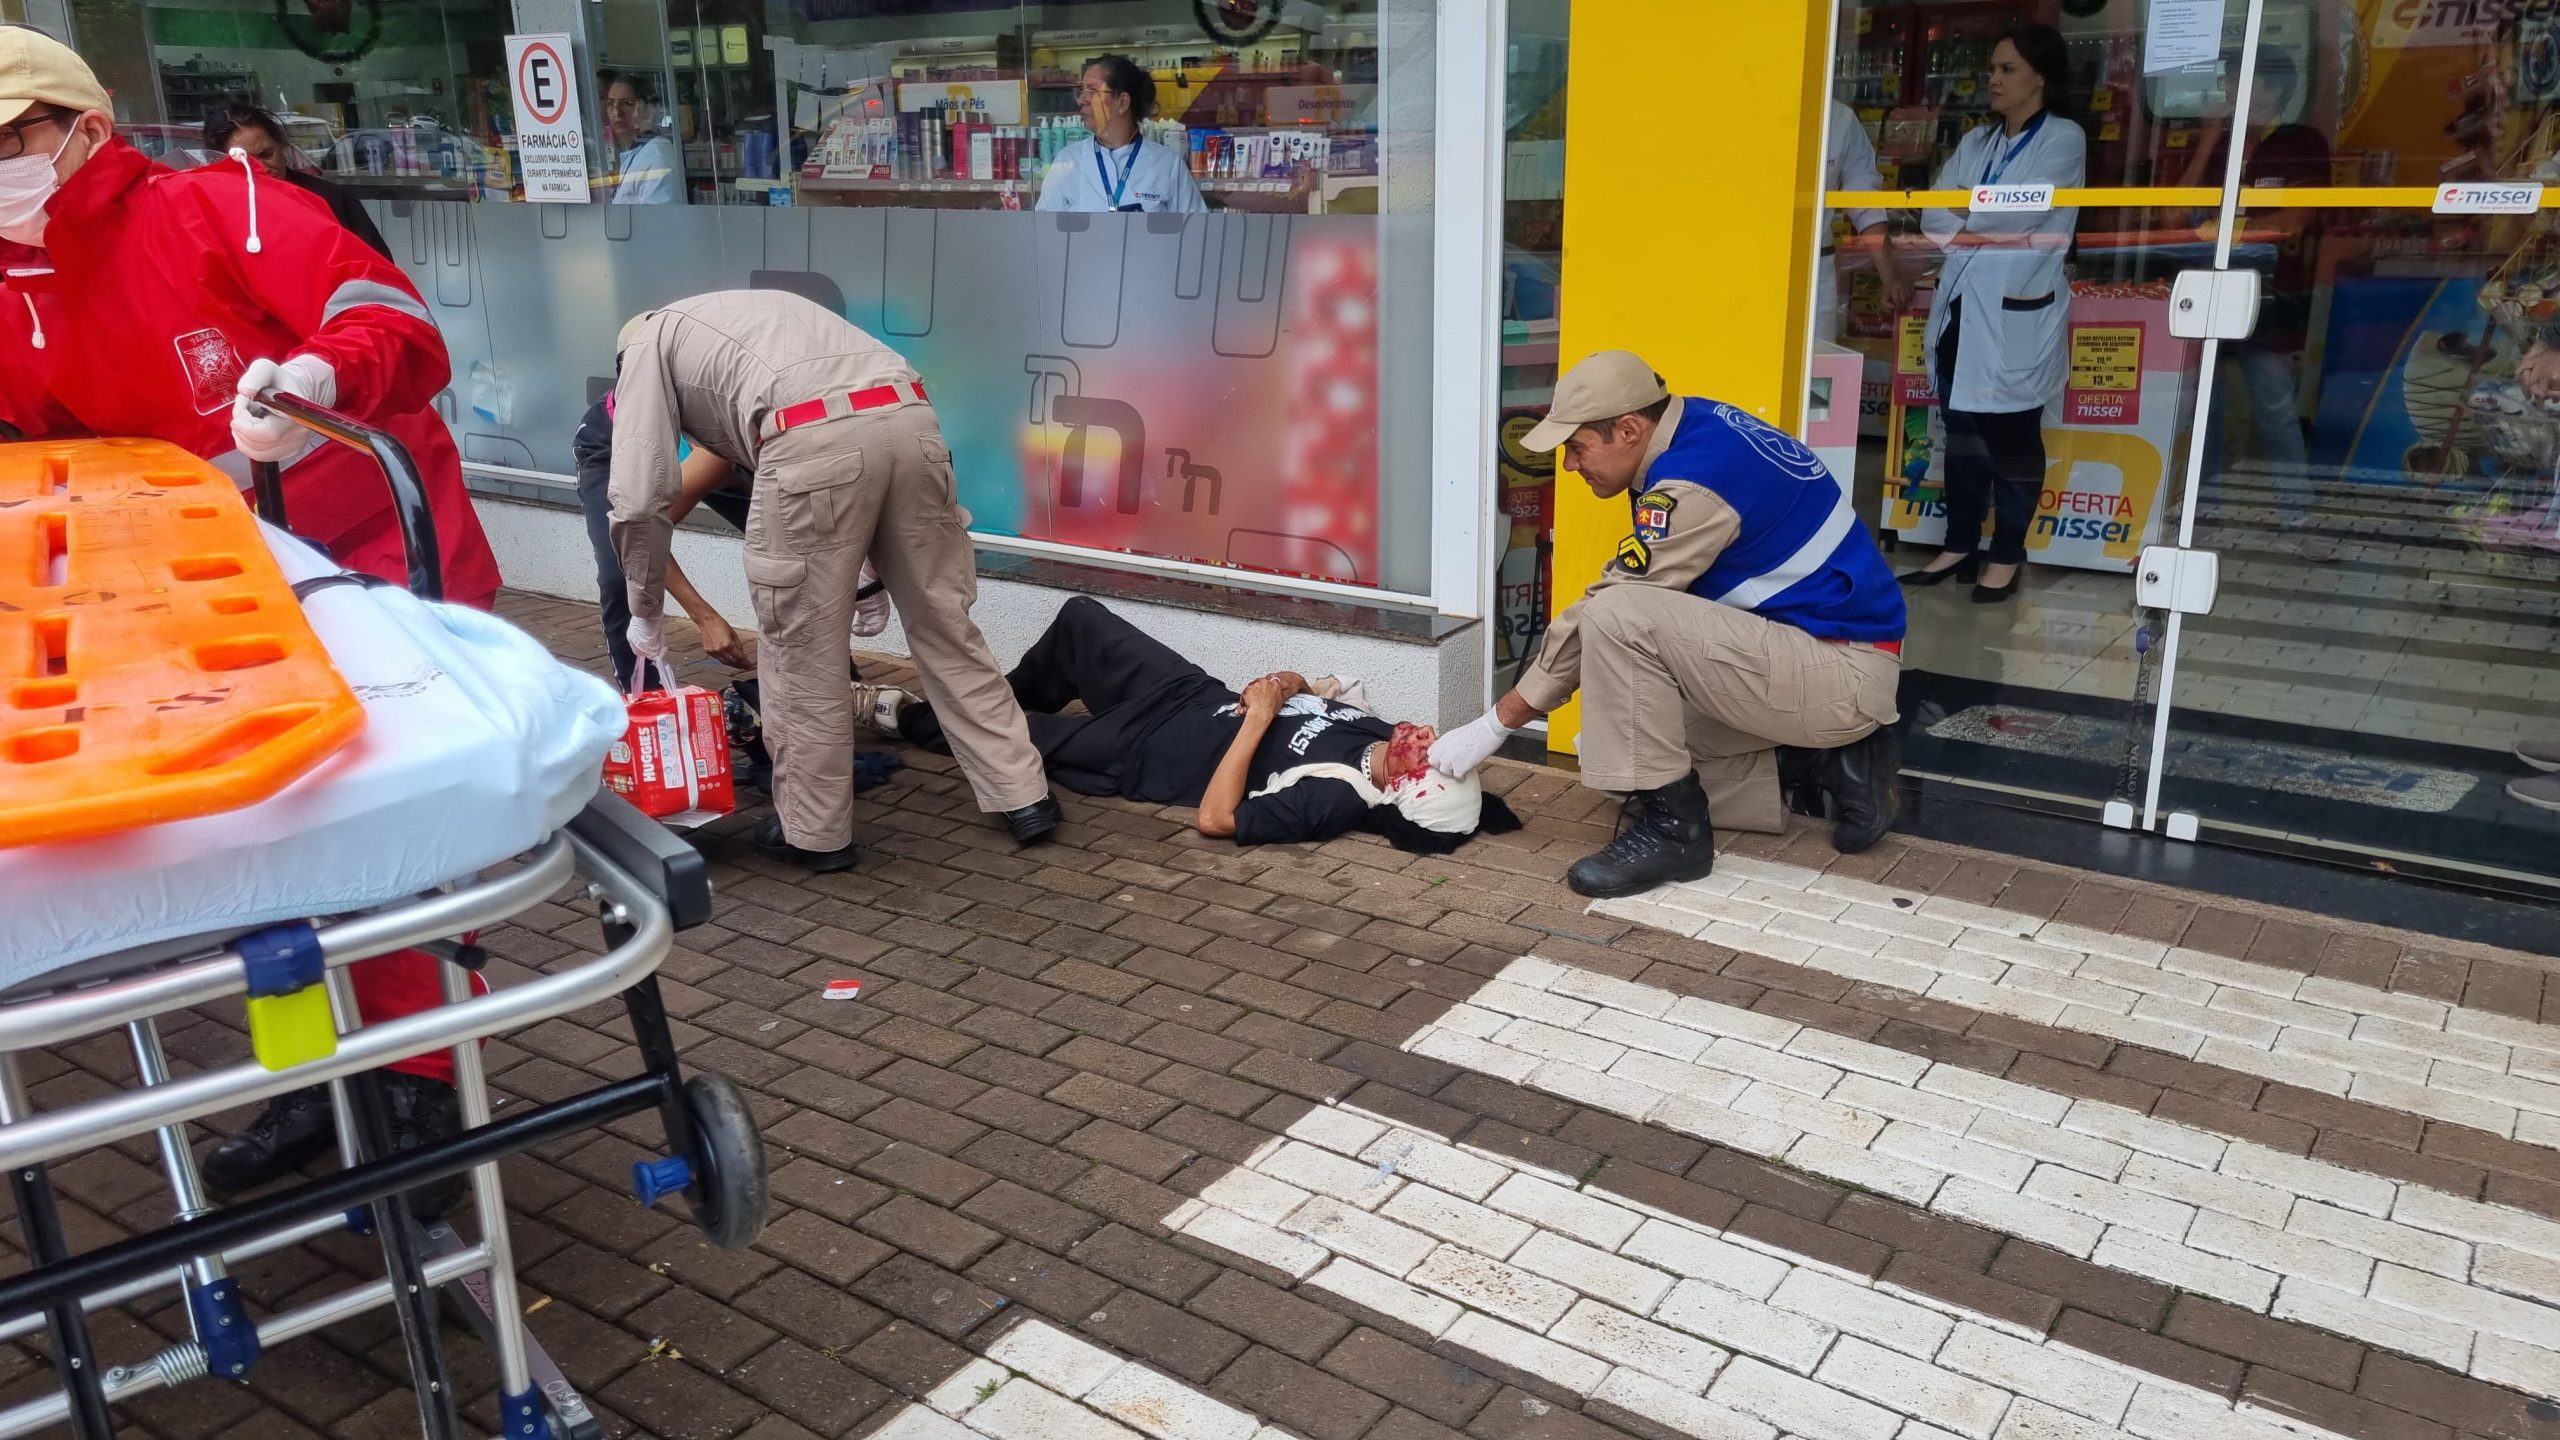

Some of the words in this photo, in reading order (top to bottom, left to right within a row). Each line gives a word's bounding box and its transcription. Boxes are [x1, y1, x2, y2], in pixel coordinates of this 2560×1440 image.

[531, 58, 554, 108] E
[961, 101, 967, 110] e
[970, 96, 985, 110] Pés
[521, 130, 568, 149] FARMÁCIA
[524, 154, 548, 164] EXCLUSIVO
[549, 154, 560, 164] PARA
[561, 154, 582, 164] CLIENTES
[527, 168, 547, 178] DURANTE
[548, 169, 551, 177] A
[551, 167, 583, 178] PERMANÊNCIA
[874, 166, 890, 174] KISS
[541, 183, 548, 192] NA
[548, 181, 571, 192] FARMÁCIA
[1994, 190, 2046, 203] nissei
[2465, 190, 2532, 204] nissei
[2078, 394, 2123, 405] OFERTA
[2077, 405, 2123, 417] nissei
[2038, 489, 2133, 518] OFERTA
[2036, 515, 2131, 543] nissei
[638, 726, 656, 782] HUGGIES
